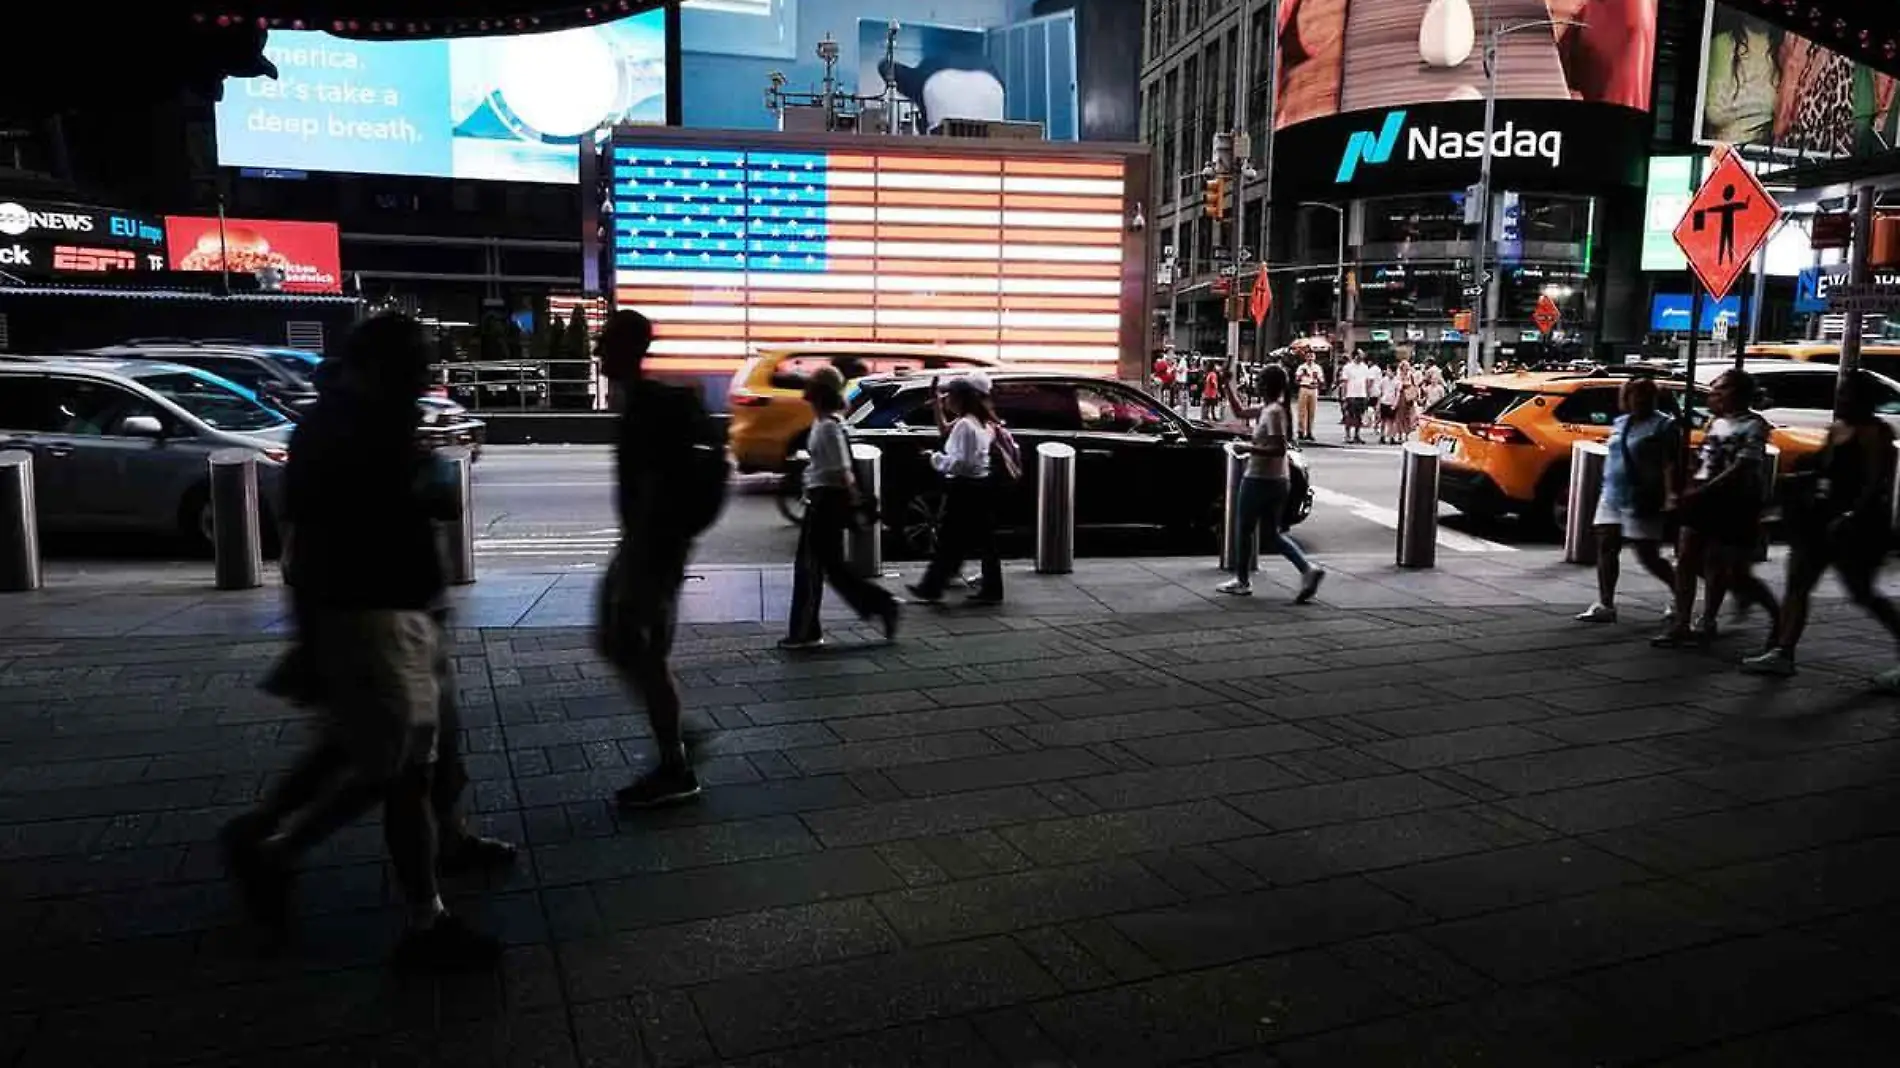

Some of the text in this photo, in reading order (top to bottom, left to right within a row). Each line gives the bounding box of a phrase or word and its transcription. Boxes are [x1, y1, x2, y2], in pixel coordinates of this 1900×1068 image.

[267, 44, 366, 70] merica.
[245, 76, 399, 106] Let's take a
[247, 107, 423, 146] deep breath.
[1407, 121, 1562, 168] Nasdaq
[30, 211, 93, 232] NEWS
[110, 216, 136, 237] EU
[53, 246, 136, 271] ESPN
